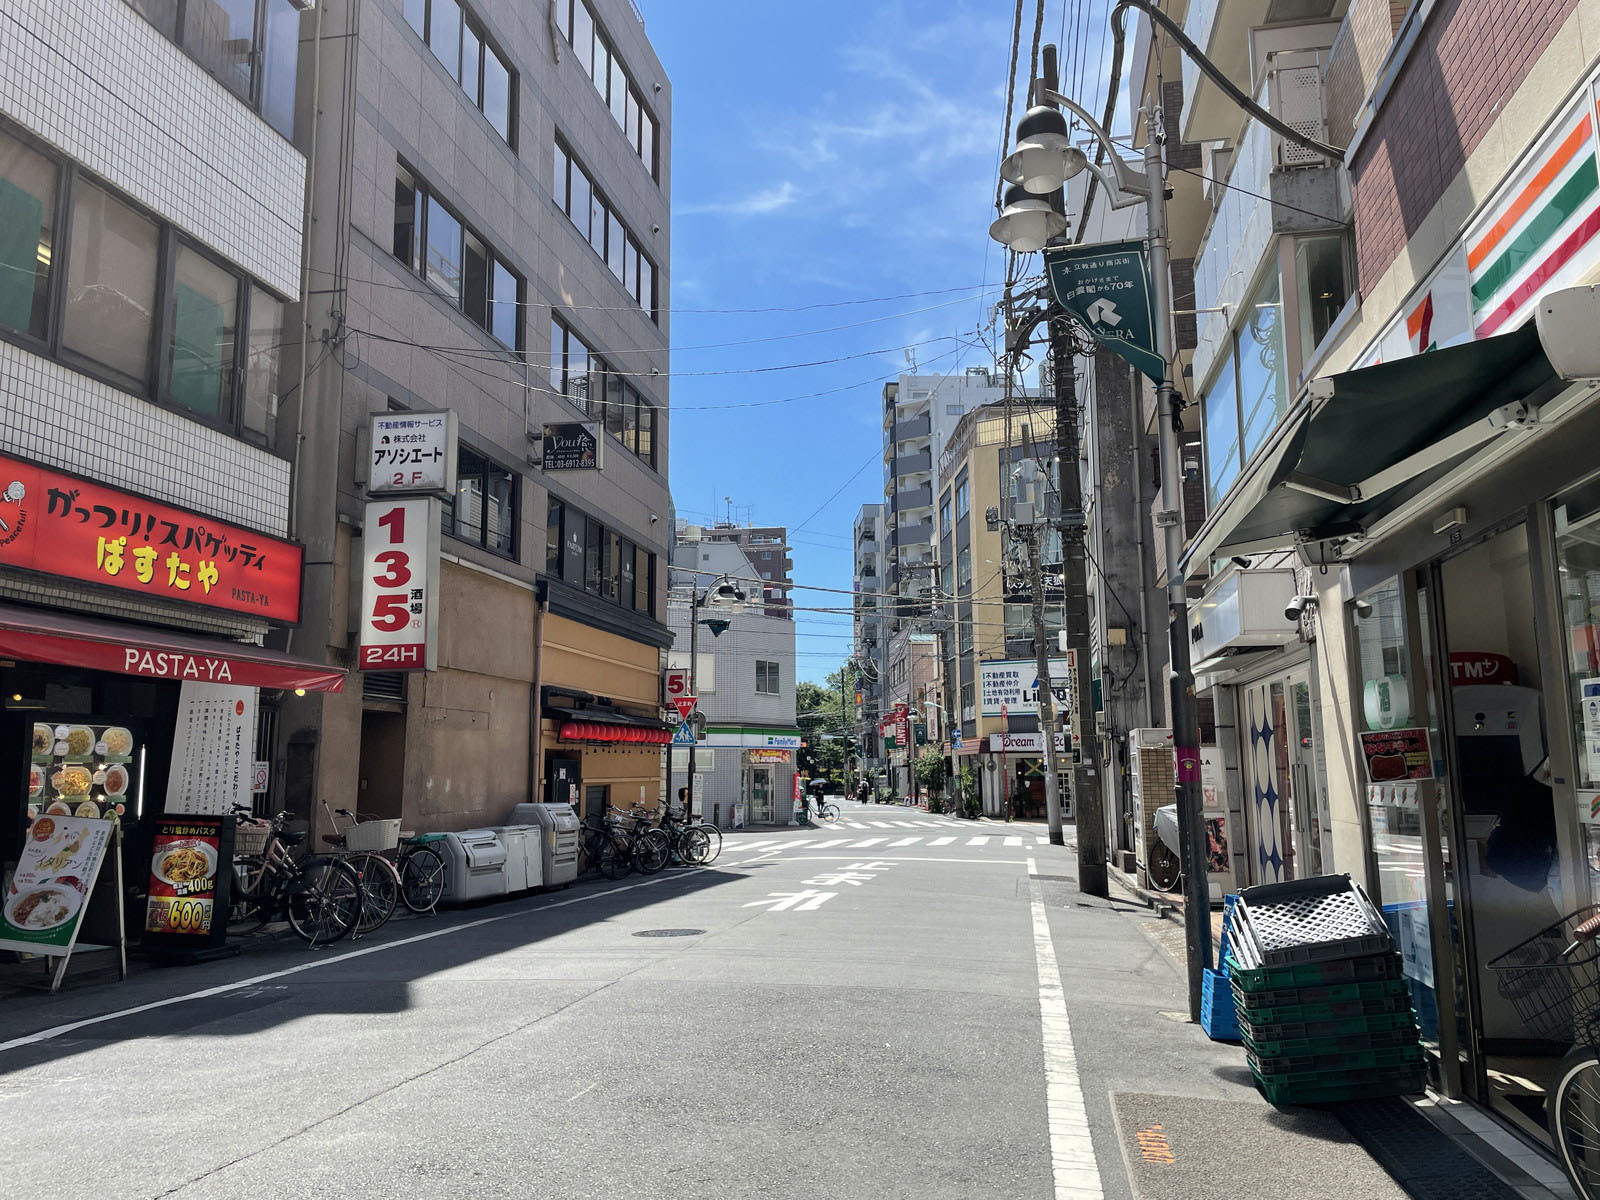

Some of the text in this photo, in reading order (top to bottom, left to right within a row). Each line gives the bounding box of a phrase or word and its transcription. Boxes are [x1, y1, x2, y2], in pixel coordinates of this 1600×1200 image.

[377, 419, 443, 429] 不動産情報サービス
[393, 434, 426, 443] 株式会社
[374, 446, 443, 466] アソシエート
[47, 487, 266, 571] がっつり!スパゲッティ
[97, 536, 220, 595] ぱすたや
[231, 587, 269, 607] PASTA-YA
[410, 588, 424, 615] 酒場
[366, 647, 418, 663] 24H
[124, 648, 232, 682] PASTA-YA
[1450, 661, 1483, 678] TM
[985, 671, 1019, 679] 不動産買取
[667, 675, 684, 693] 5
[985, 680, 1019, 688] 不動産仲介
[985, 689, 1021, 697] 土地有効利用
[774, 737, 797, 746] FamilyMart
[1003, 736, 1035, 747] Dream
[37, 854, 83, 870] イタリアン
[741, 861, 899, 912] 止まれ
[169, 900, 204, 930] 600
